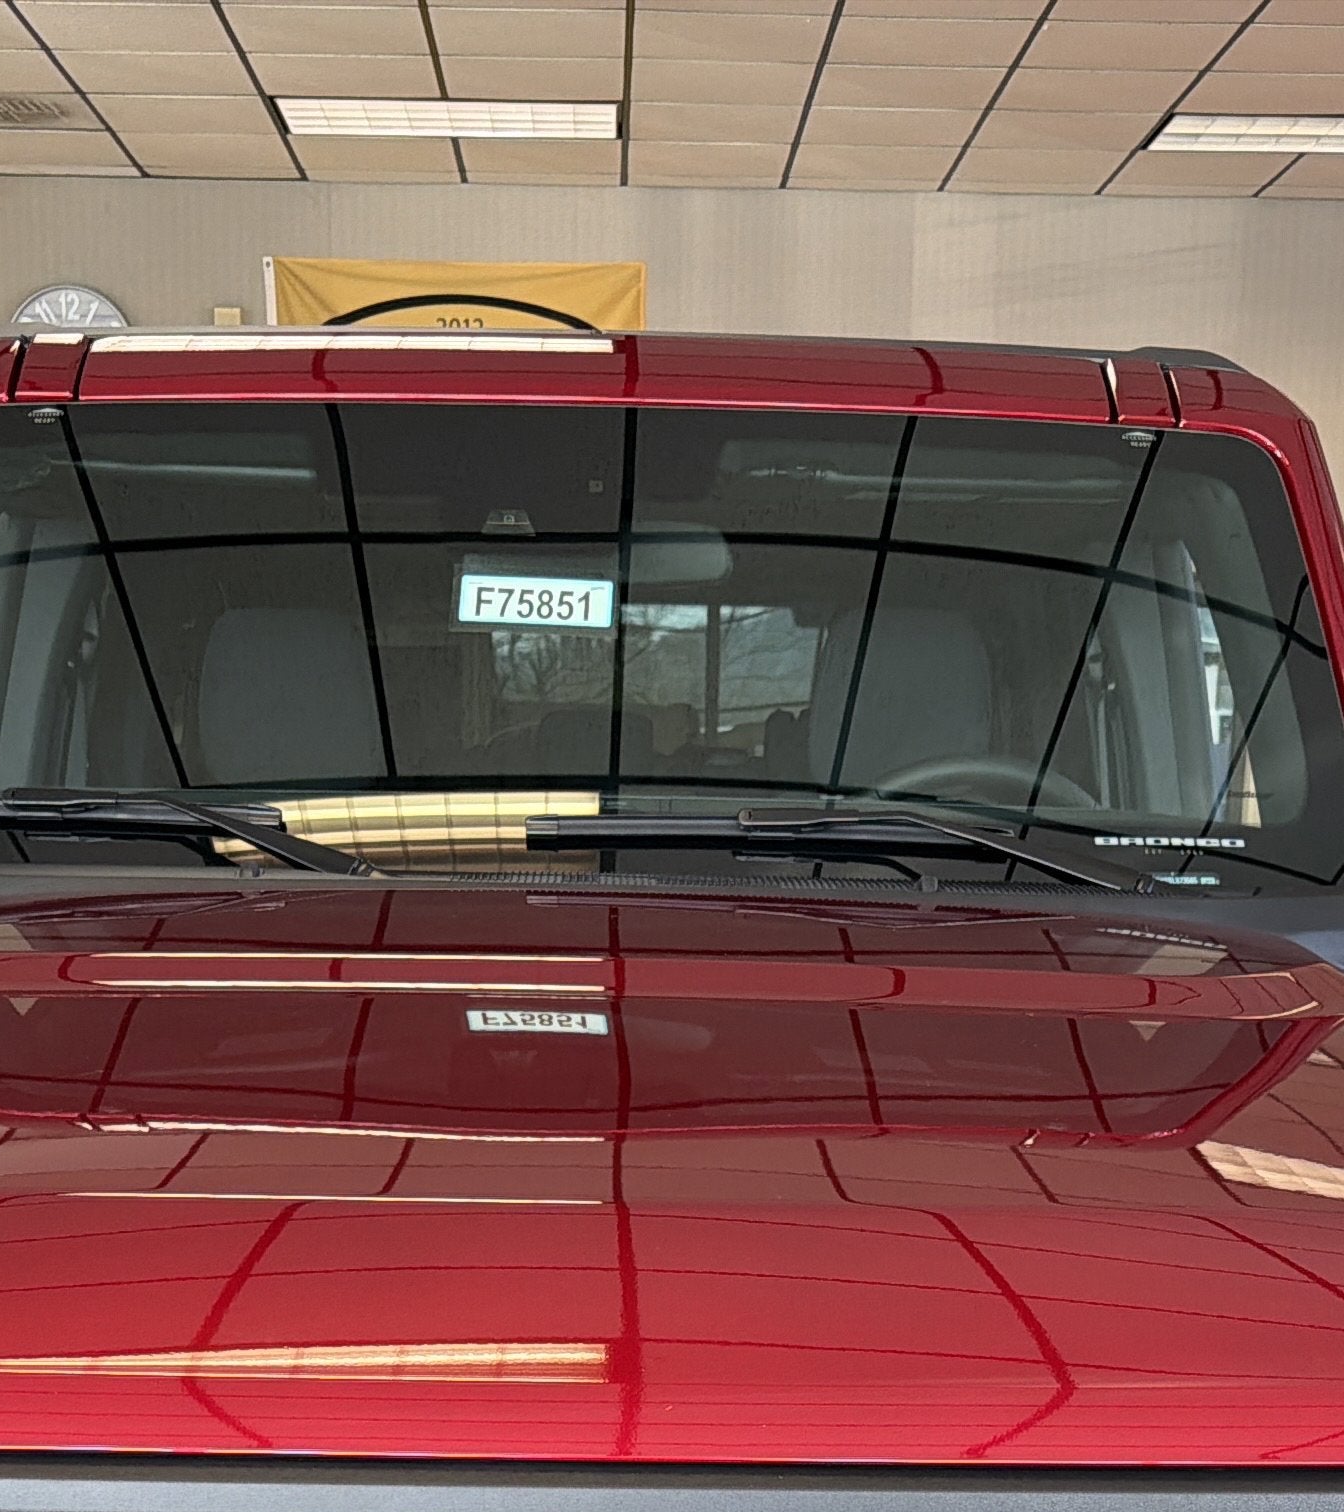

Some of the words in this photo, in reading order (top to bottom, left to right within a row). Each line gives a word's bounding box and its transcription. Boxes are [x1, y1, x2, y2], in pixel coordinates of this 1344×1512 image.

[59, 292, 81, 320] 12
[474, 586, 592, 622] F75851
[1093, 836, 1246, 848] BRONCO
